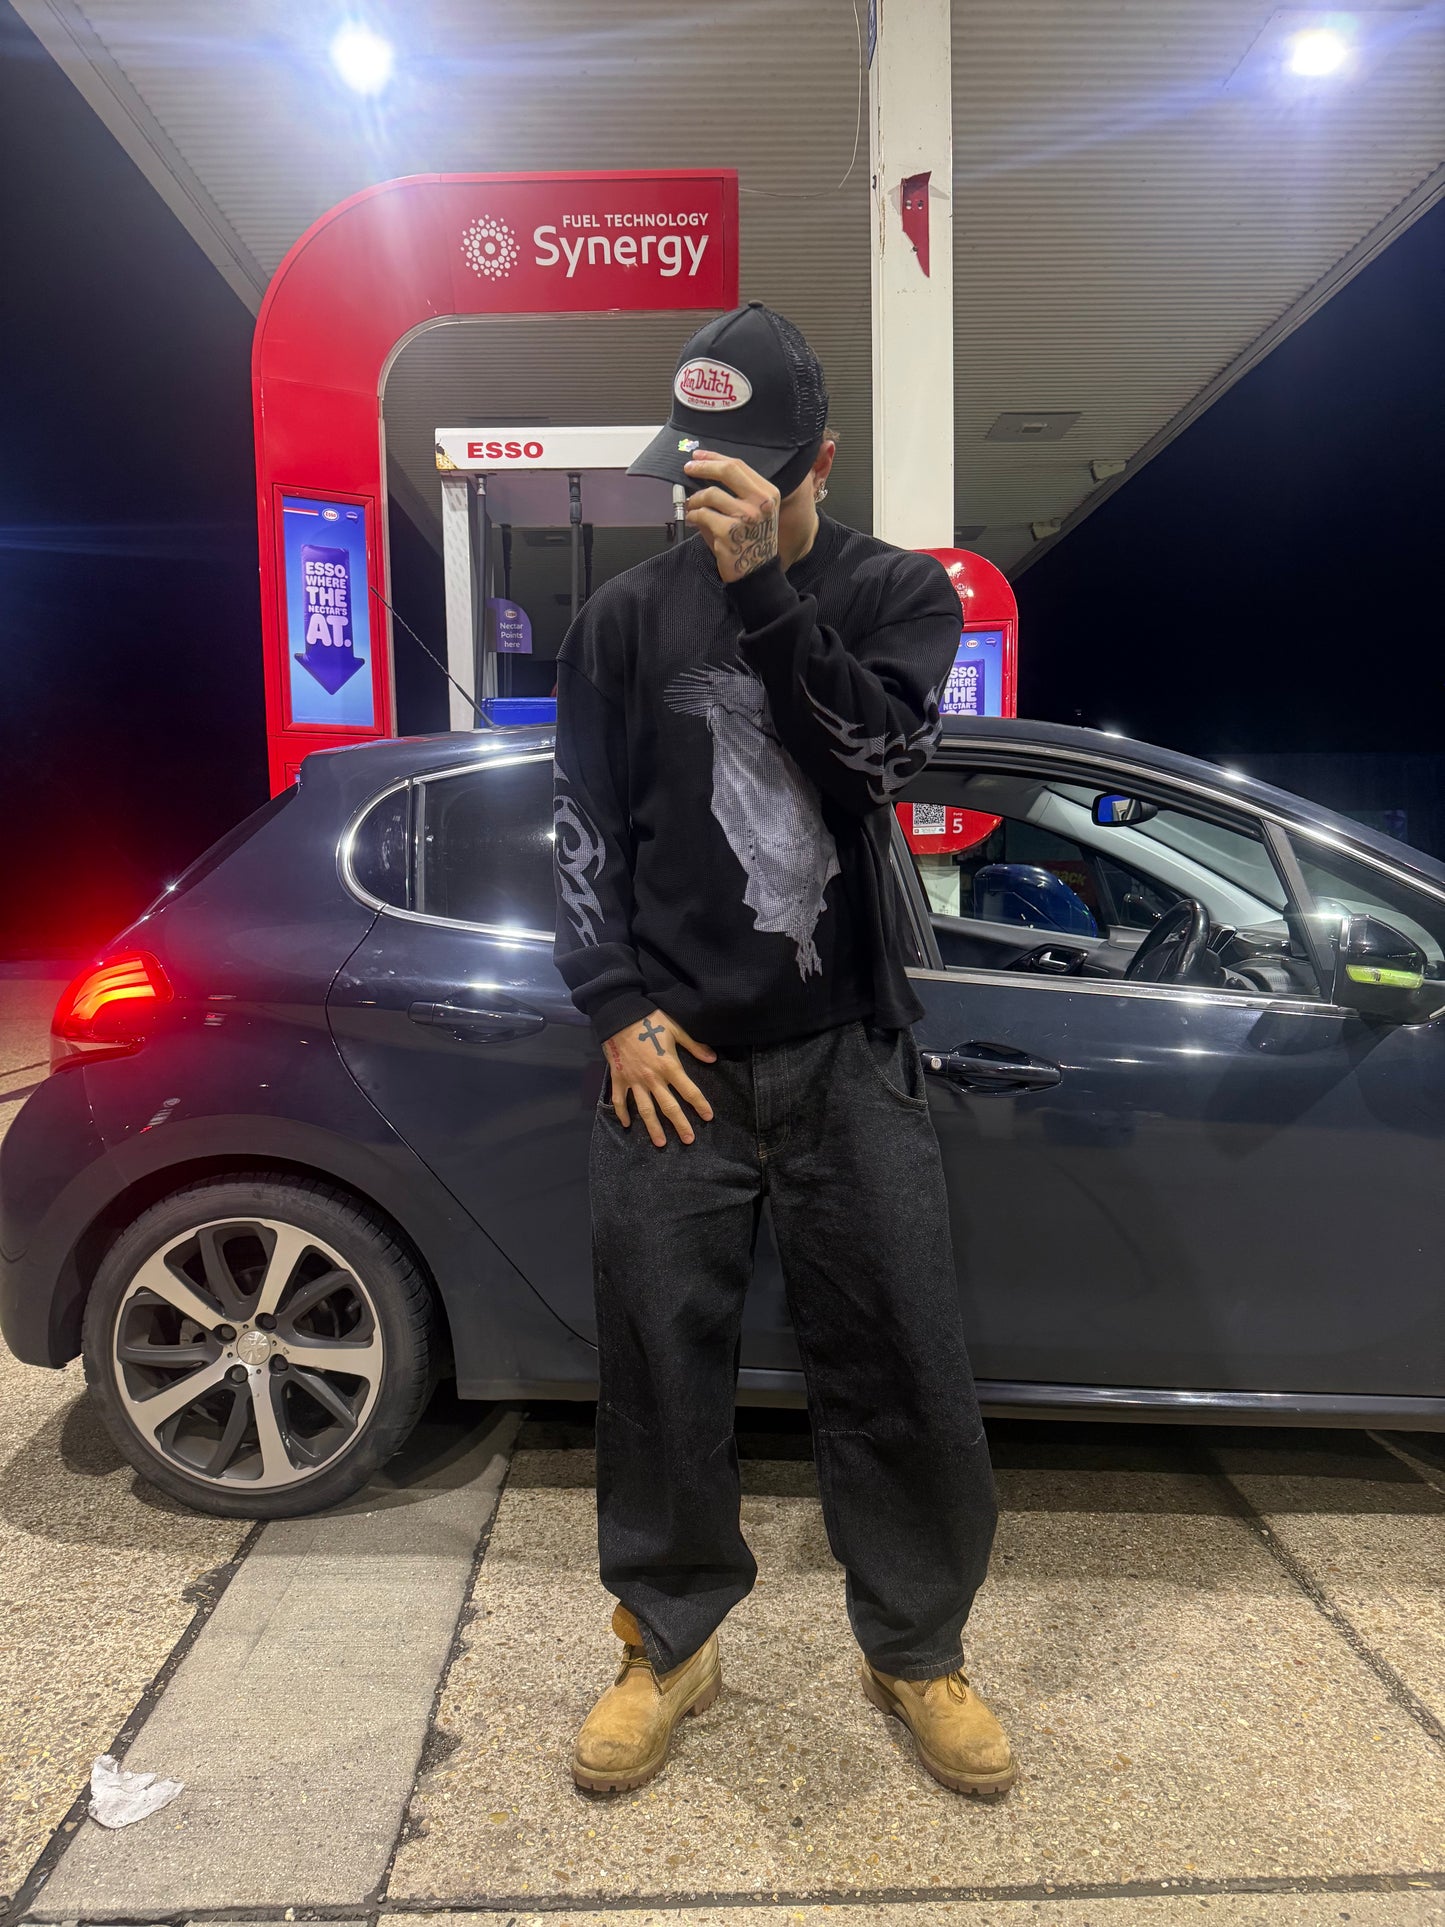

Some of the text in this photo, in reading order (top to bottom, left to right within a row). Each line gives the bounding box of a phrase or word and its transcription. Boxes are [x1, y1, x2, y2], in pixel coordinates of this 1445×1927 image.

[562, 213, 709, 228] FUEL TECHNOLOGY
[533, 225, 709, 278] Synergy
[695, 368, 734, 395] Dutch
[467, 441, 544, 459] ESSO
[305, 561, 349, 579] ESSO.
[305, 575, 347, 589] WHERE
[305, 586, 348, 608] THE
[308, 605, 348, 616] NECTAR'S
[306, 613, 352, 648] AT.
[499, 622, 524, 630] Nectar
[500, 631, 524, 639] Points
[504, 640, 521, 648] here
[949, 666, 979, 679] SSO.
[943, 687, 977, 704] THE
[943, 702, 977, 711] NECTAR'S
[952, 818, 963, 834] 5
